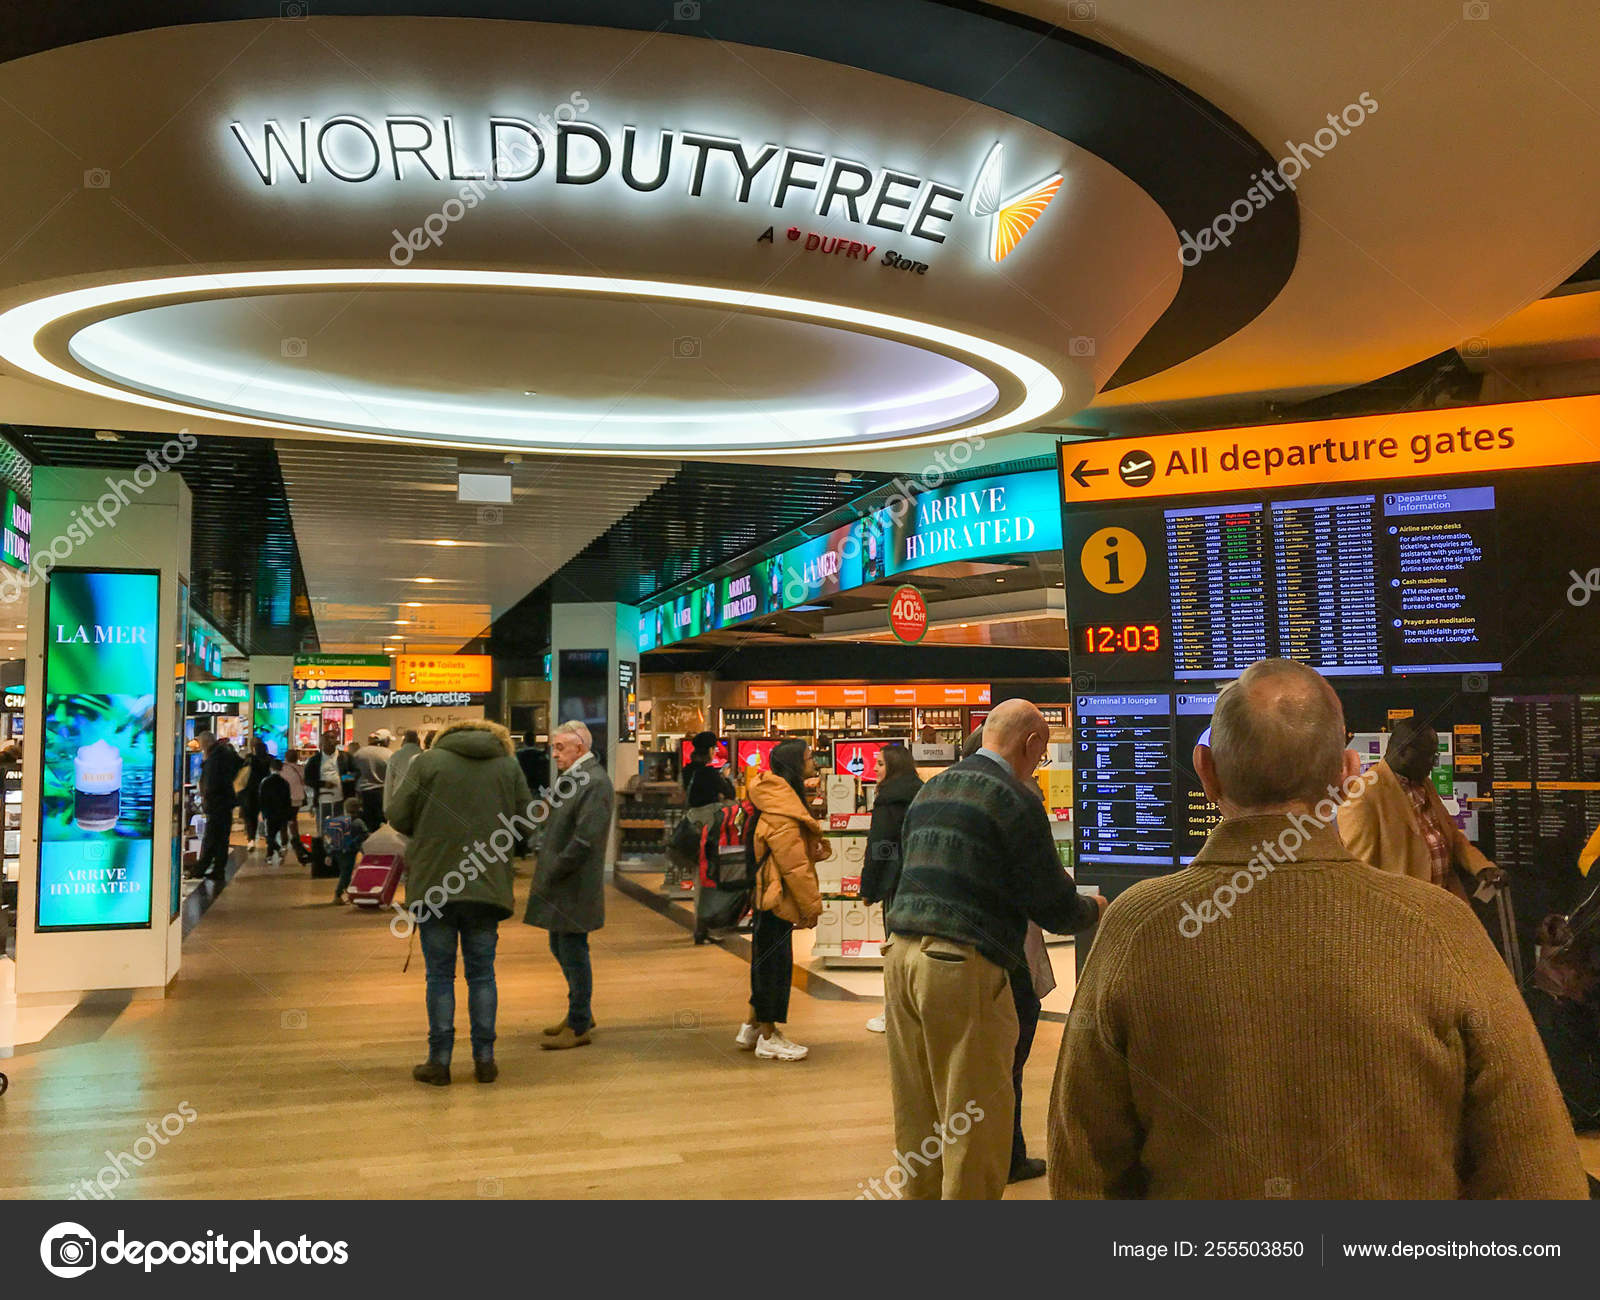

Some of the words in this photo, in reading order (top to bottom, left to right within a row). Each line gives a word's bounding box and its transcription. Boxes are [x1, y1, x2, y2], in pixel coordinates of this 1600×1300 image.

[757, 226, 774, 244] A
[804, 232, 877, 262] DUFRY
[881, 250, 929, 275] Store
[1165, 448, 1209, 477] All
[1220, 433, 1399, 478] departure
[1410, 423, 1516, 464] gates
[1398, 493, 1447, 504] Departures
[919, 488, 1007, 528] ARRIVE
[1398, 502, 1451, 512] information
[905, 516, 1036, 562] HYDRATED
[56, 624, 90, 644] LA
[94, 625, 148, 644] MER
[1086, 625, 1160, 653] 12:03
[214, 688, 226, 696] LA
[364, 692, 388, 708] Duty
[390, 691, 412, 704] Free
[414, 691, 472, 708] Cigarettes
[1089, 697, 1121, 705] Terminal
[1128, 696, 1158, 706] lounges
[196, 700, 228, 713] Dior
[423, 714, 446, 726] Duty
[1081, 716, 1087, 725] B
[1081, 730, 1088, 738] C
[1082, 744, 1088, 752] D
[1082, 771, 1088, 779] E
[1082, 785, 1088, 793] F
[1082, 802, 1088, 810] F
[1083, 829, 1090, 837] H
[1084, 842, 1090, 850] H
[68, 868, 128, 881] ARRIVE
[50, 881, 142, 896] HYDRATED
